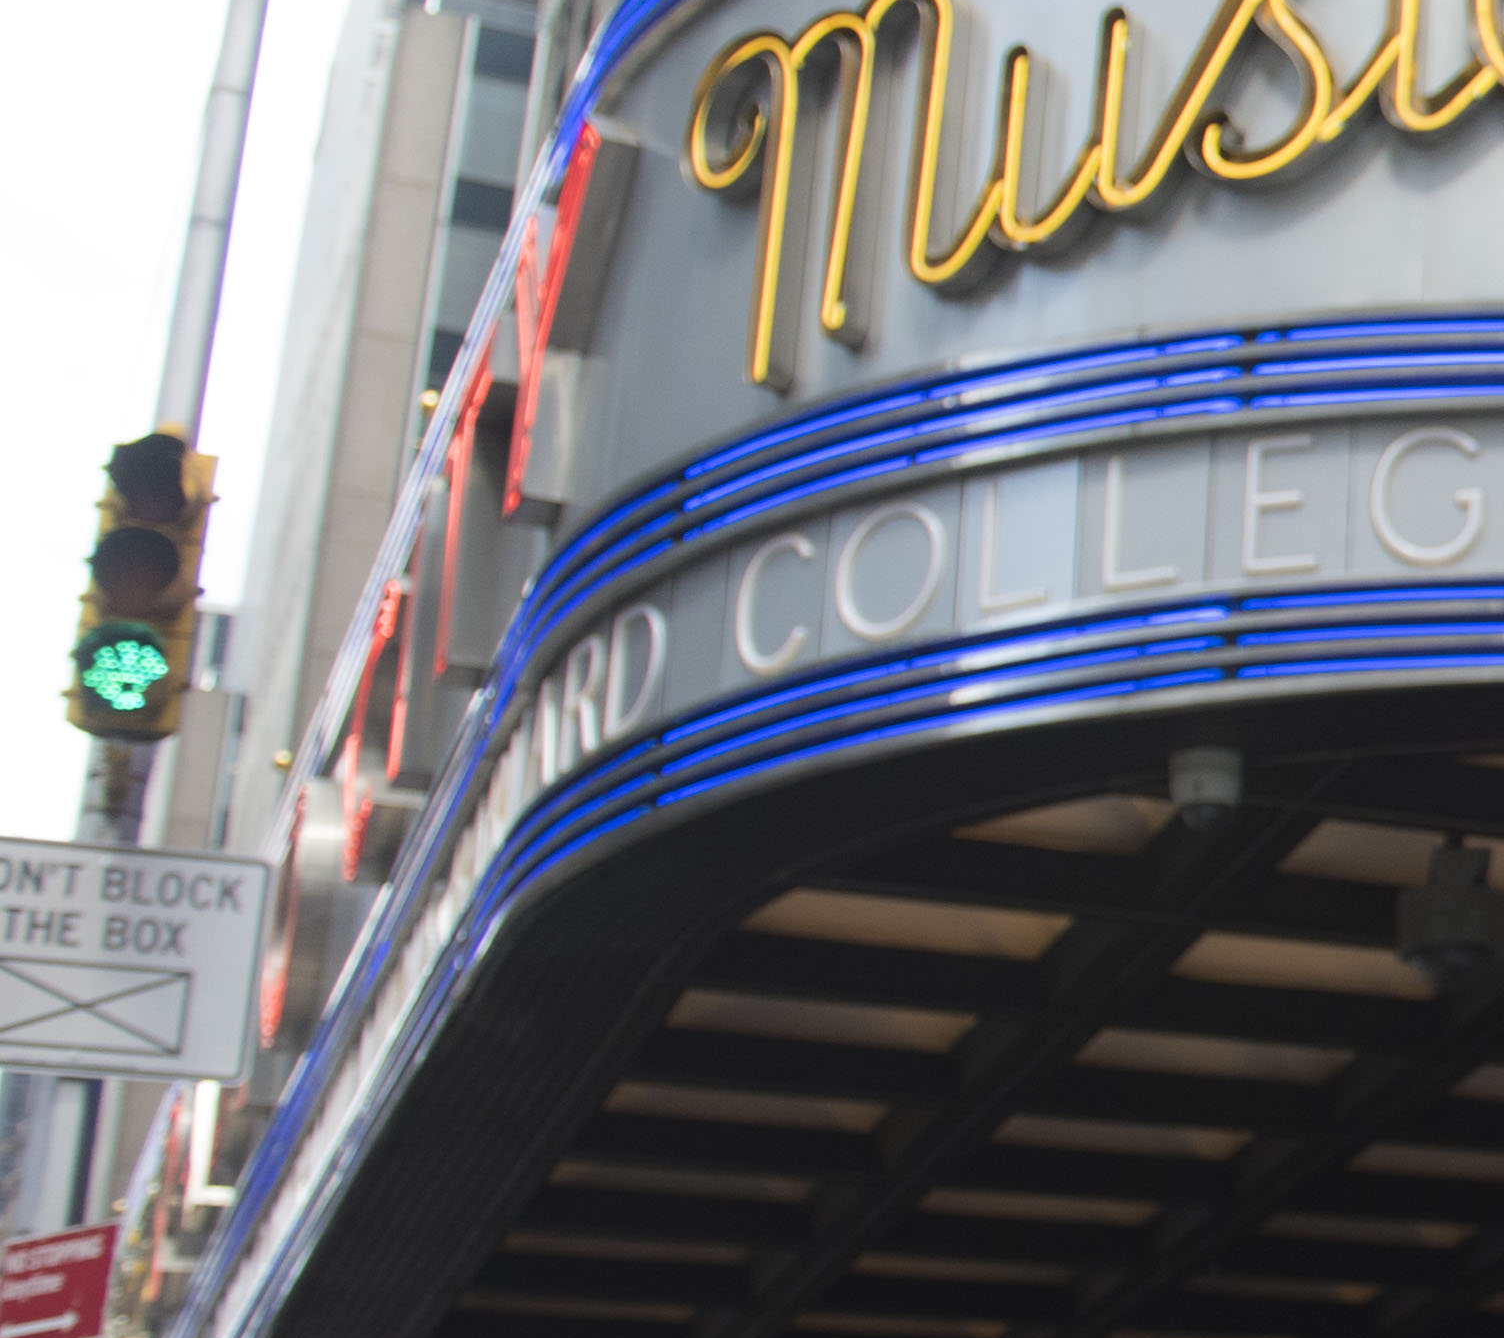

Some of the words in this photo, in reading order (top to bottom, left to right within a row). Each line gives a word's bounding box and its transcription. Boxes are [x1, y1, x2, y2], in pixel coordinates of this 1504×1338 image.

[101, 865, 244, 912] BLOCK
[4, 907, 81, 948] THE
[102, 914, 187, 956] BOX
